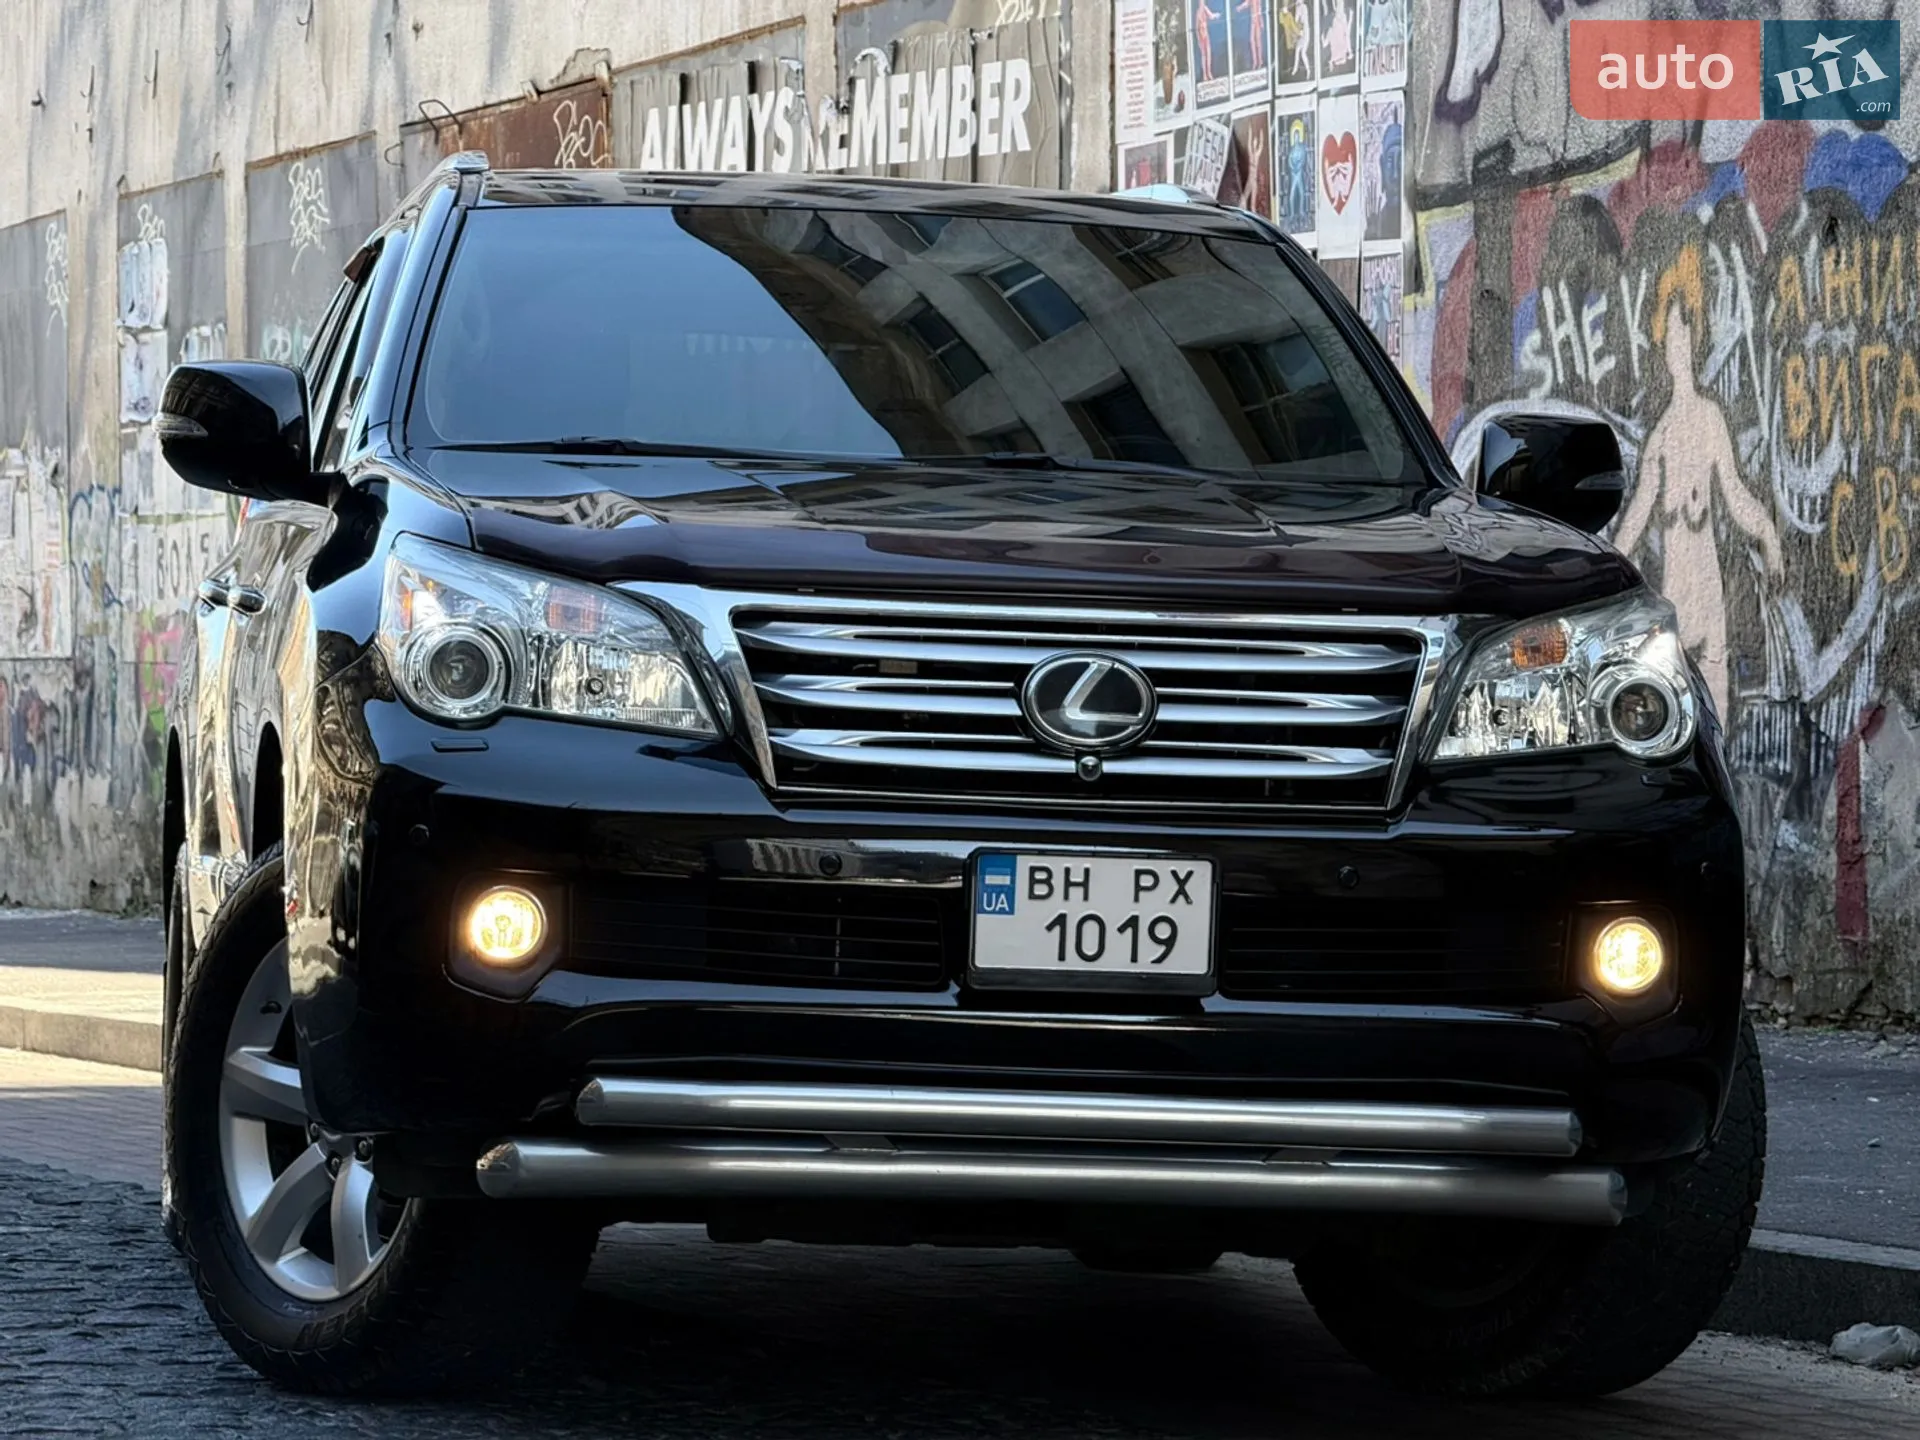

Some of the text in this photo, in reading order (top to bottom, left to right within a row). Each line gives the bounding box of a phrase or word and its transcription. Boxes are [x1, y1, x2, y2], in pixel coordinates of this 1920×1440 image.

[640, 86, 795, 173] ALWAYS
[1519, 278, 1617, 400] SHE
[983, 893, 1010, 911] UA
[1028, 865, 1194, 905] BH PX
[1045, 912, 1178, 964] 1019
